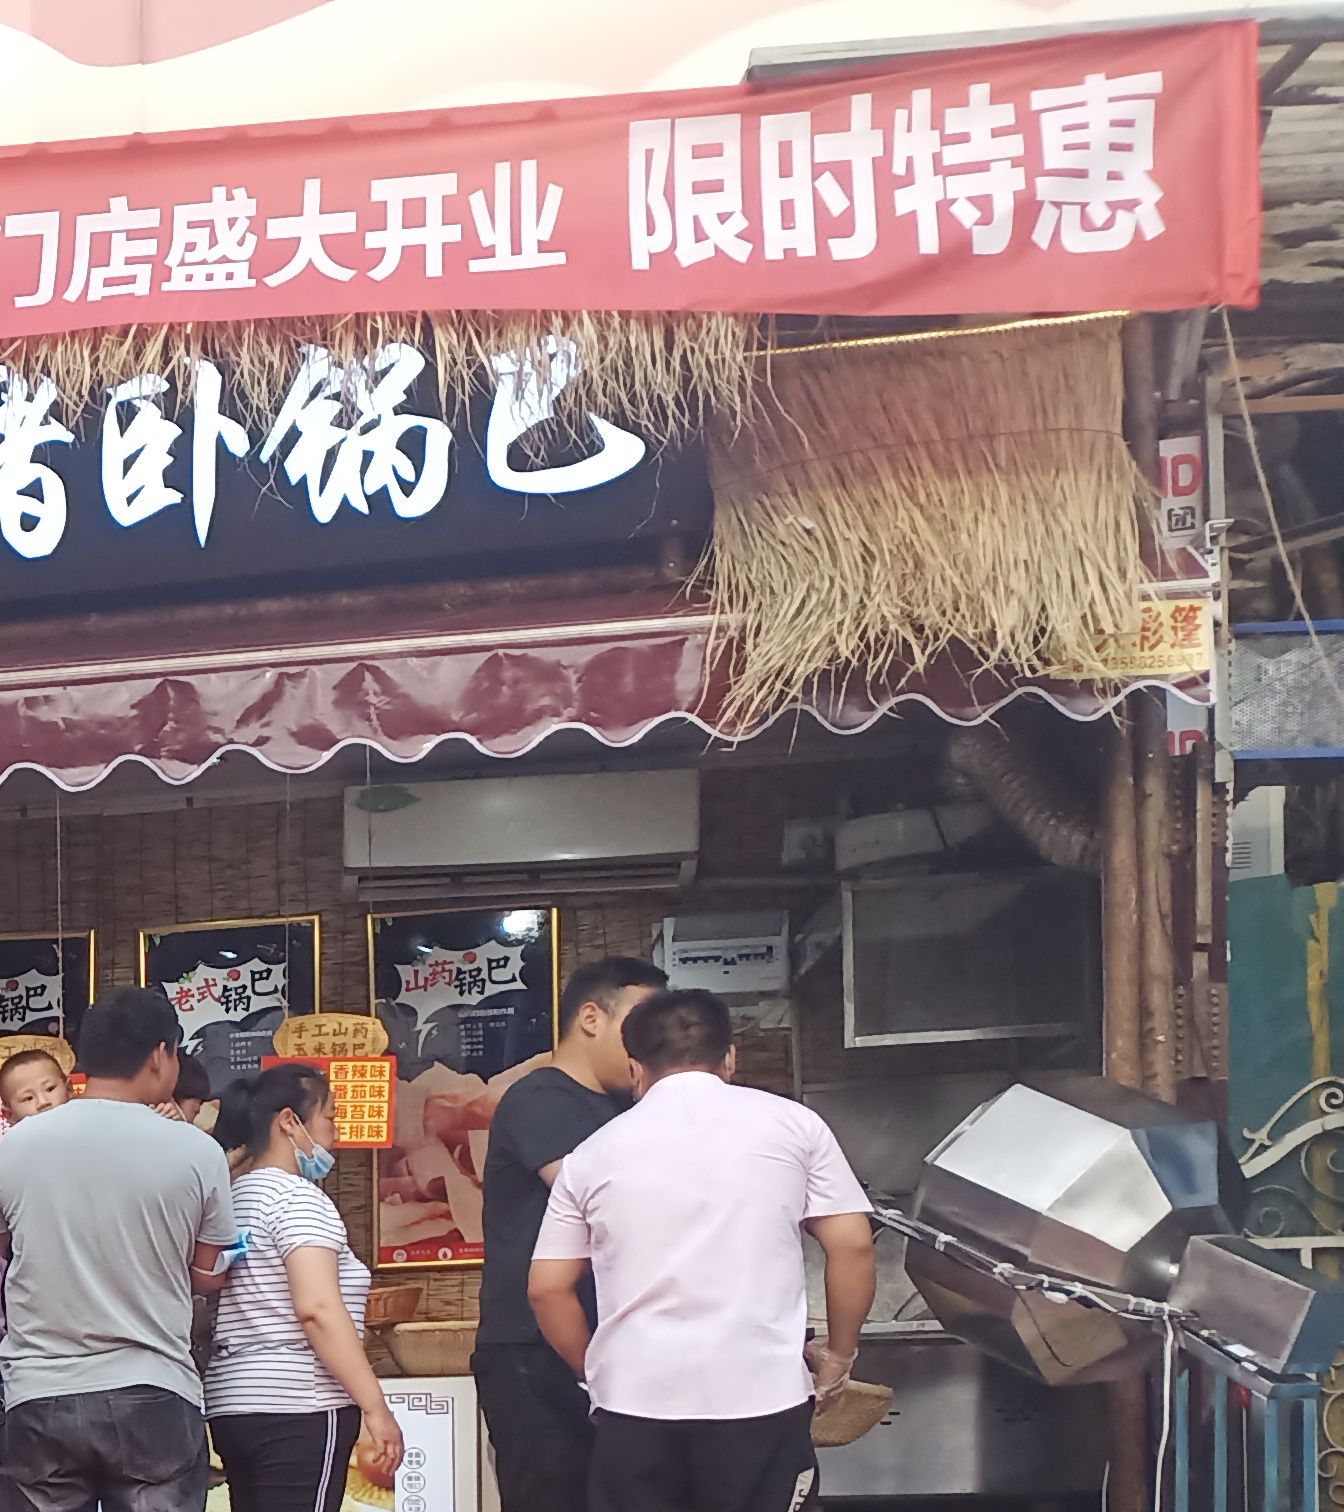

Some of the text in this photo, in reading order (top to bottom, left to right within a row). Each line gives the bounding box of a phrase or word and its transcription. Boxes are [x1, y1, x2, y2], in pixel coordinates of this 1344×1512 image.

[628, 71, 1166, 269] 限时特惠
[170, 967, 280, 1014] 老式锅巴
[404, 955, 518, 997] 山药锅巴
[292, 1021, 370, 1040] 手工山药
[333, 1064, 387, 1080] 香辣味
[333, 1084, 386, 1100] 番茄味
